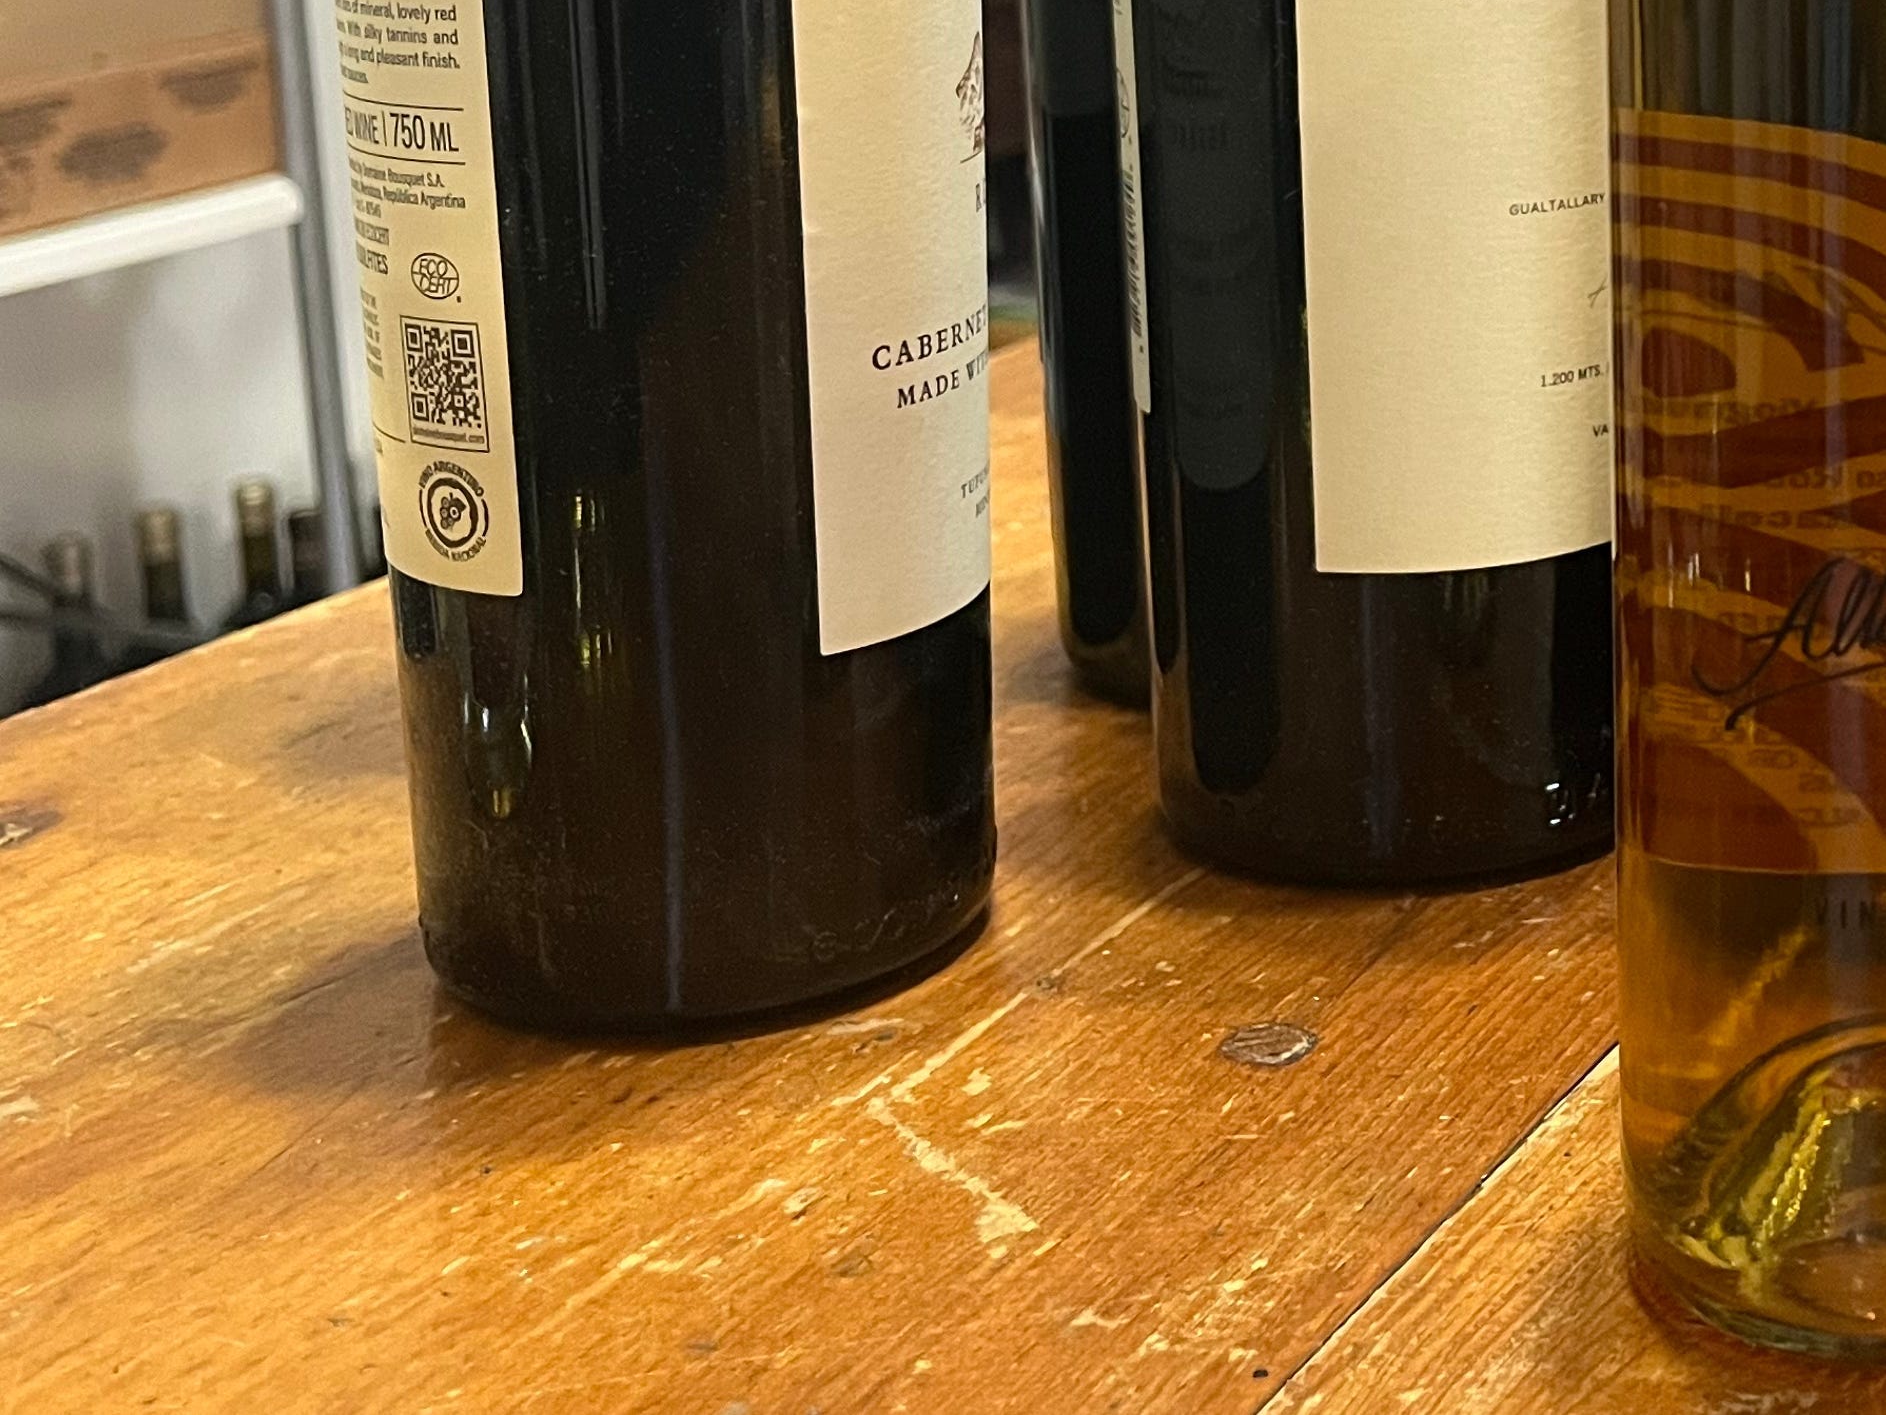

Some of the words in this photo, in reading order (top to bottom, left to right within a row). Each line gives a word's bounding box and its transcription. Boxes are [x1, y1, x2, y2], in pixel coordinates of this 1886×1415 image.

[396, 2, 431, 25] lovely
[434, 4, 457, 22] red
[386, 27, 428, 45] tannins
[433, 28, 459, 46] and
[376, 48, 420, 68] pleasant
[422, 51, 461, 70] finish.
[389, 112, 426, 149] 750
[429, 121, 460, 152] ML
[420, 191, 466, 211] Argentina
[1508, 192, 1606, 217] GUALTALLARY
[896, 369, 960, 409] MADE
